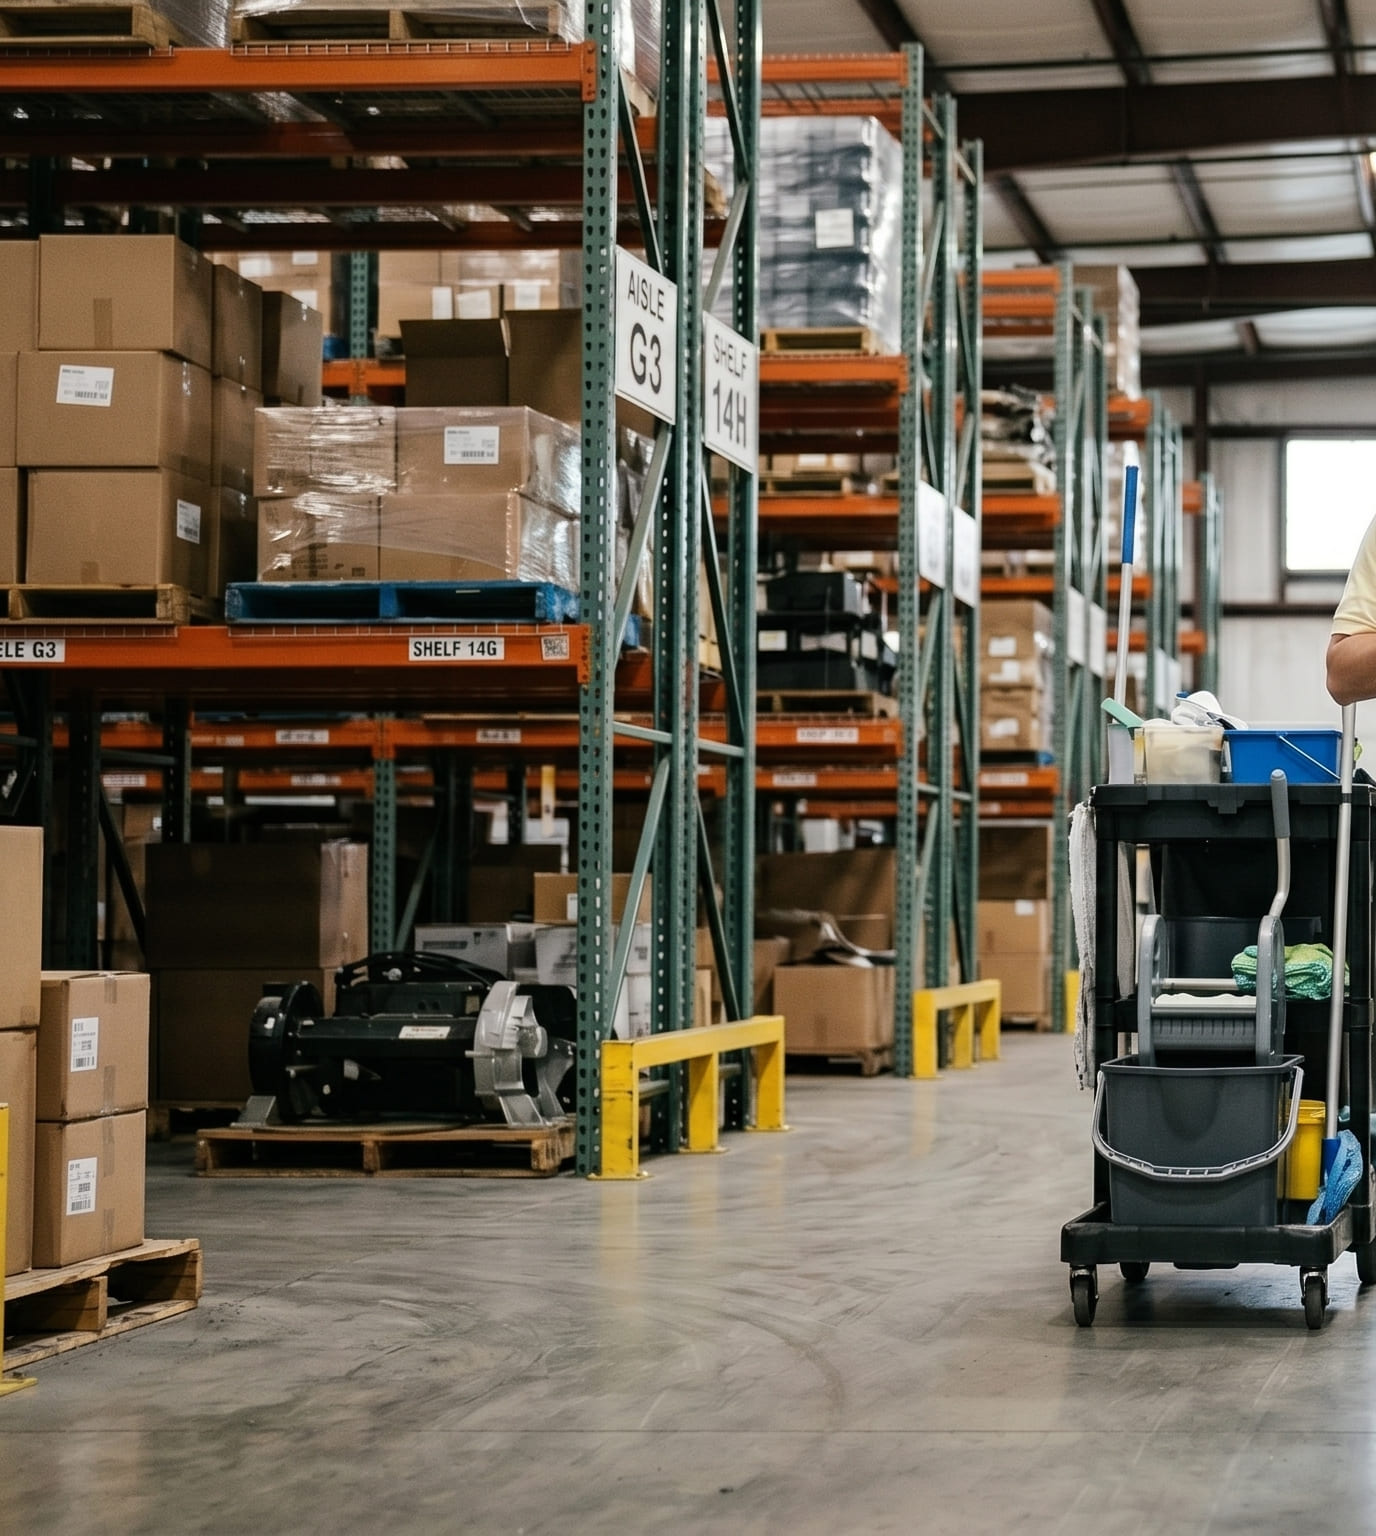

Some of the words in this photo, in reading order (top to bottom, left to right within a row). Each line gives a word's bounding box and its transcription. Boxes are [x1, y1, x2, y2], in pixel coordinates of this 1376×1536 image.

[627, 270, 665, 322] AISLE
[630, 322, 662, 394] G3
[713, 334, 747, 381] SHELF
[712, 378, 747, 448] 14H
[33, 641, 56, 658] G3
[413, 641, 461, 657] SHELF
[467, 640, 497, 657] 14G
